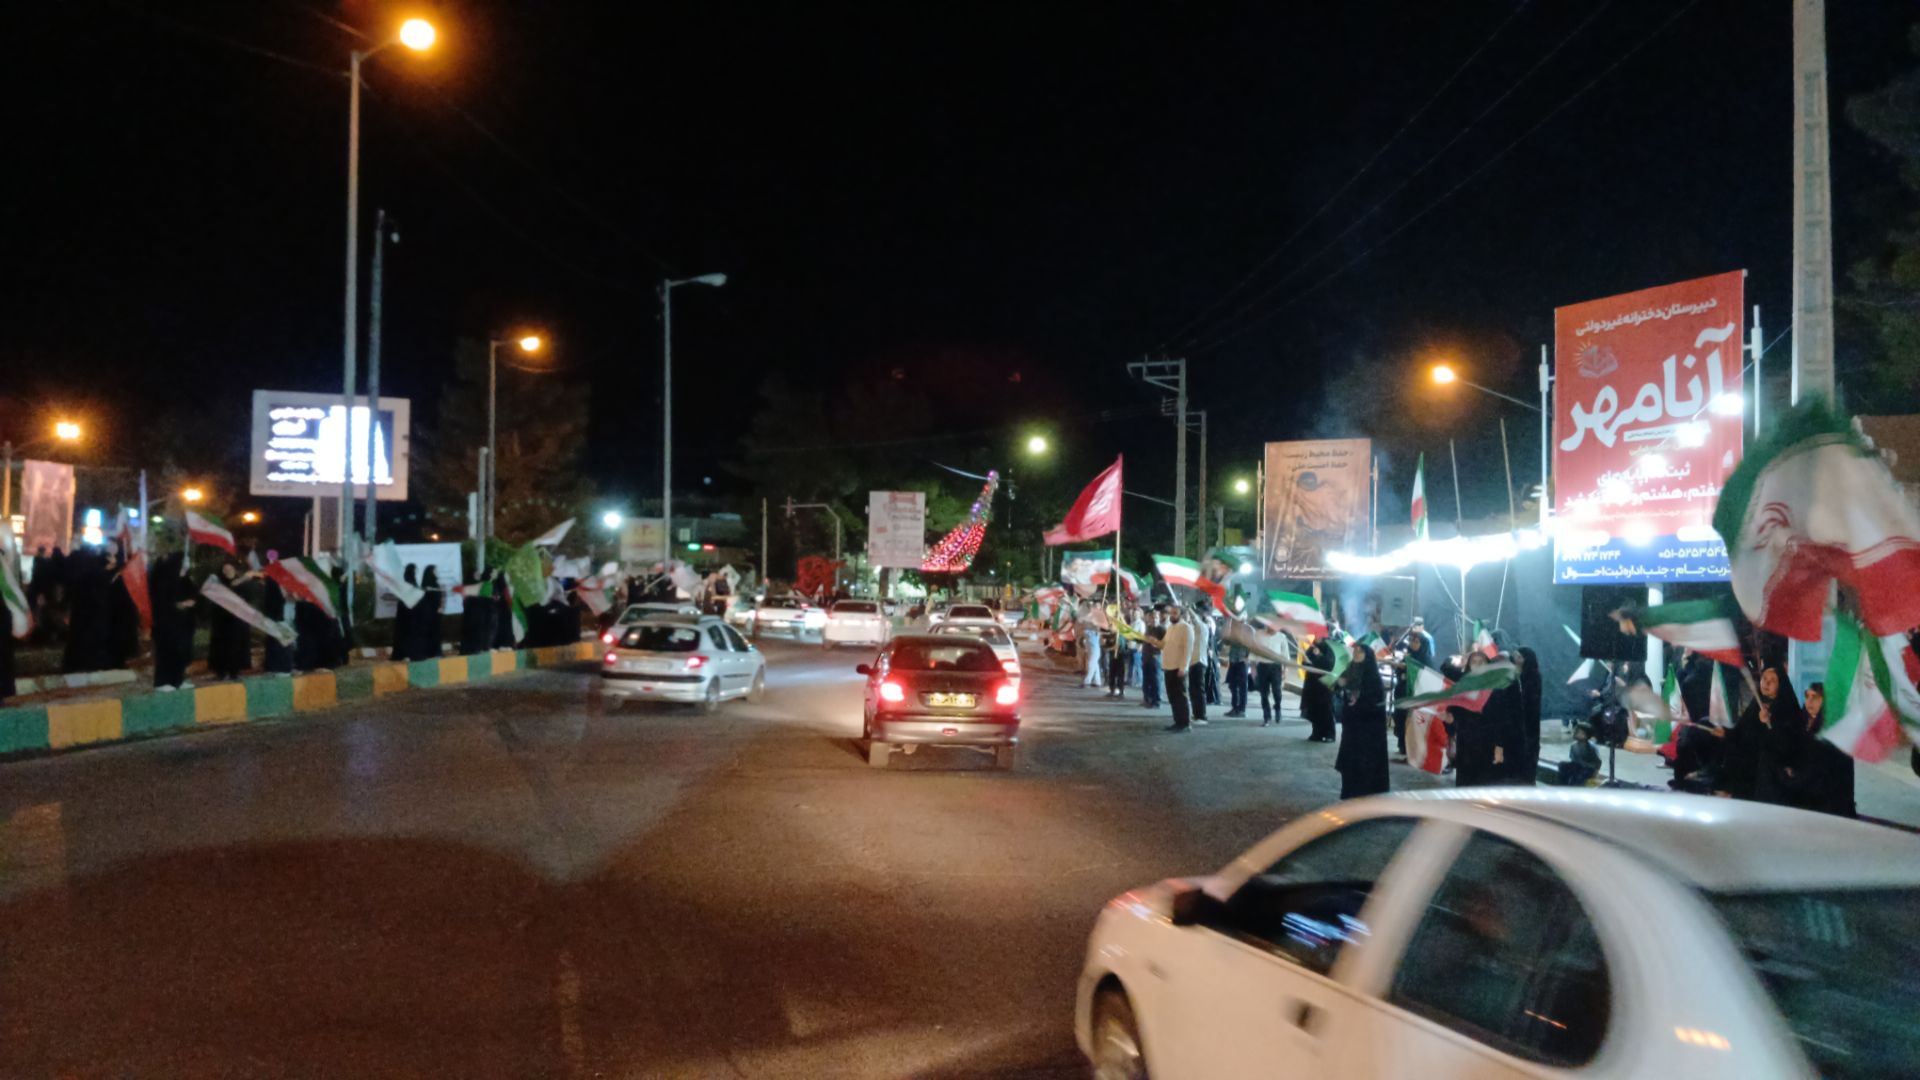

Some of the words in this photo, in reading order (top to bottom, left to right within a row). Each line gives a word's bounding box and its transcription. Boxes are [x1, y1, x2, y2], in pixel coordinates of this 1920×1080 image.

[1662, 297, 1718, 320] دبیرستان
[1624, 307, 1664, 326] دخترانه
[1665, 461, 1691, 480] ثبت
[1640, 485, 1683, 505] هشتم
[1561, 566, 1605, 580] احوال
[1605, 564, 1626, 579] ثبت
[1626, 564, 1644, 578] اداره
[1643, 565, 1669, 579] جنب
[1675, 563, 1707, 578] جام
